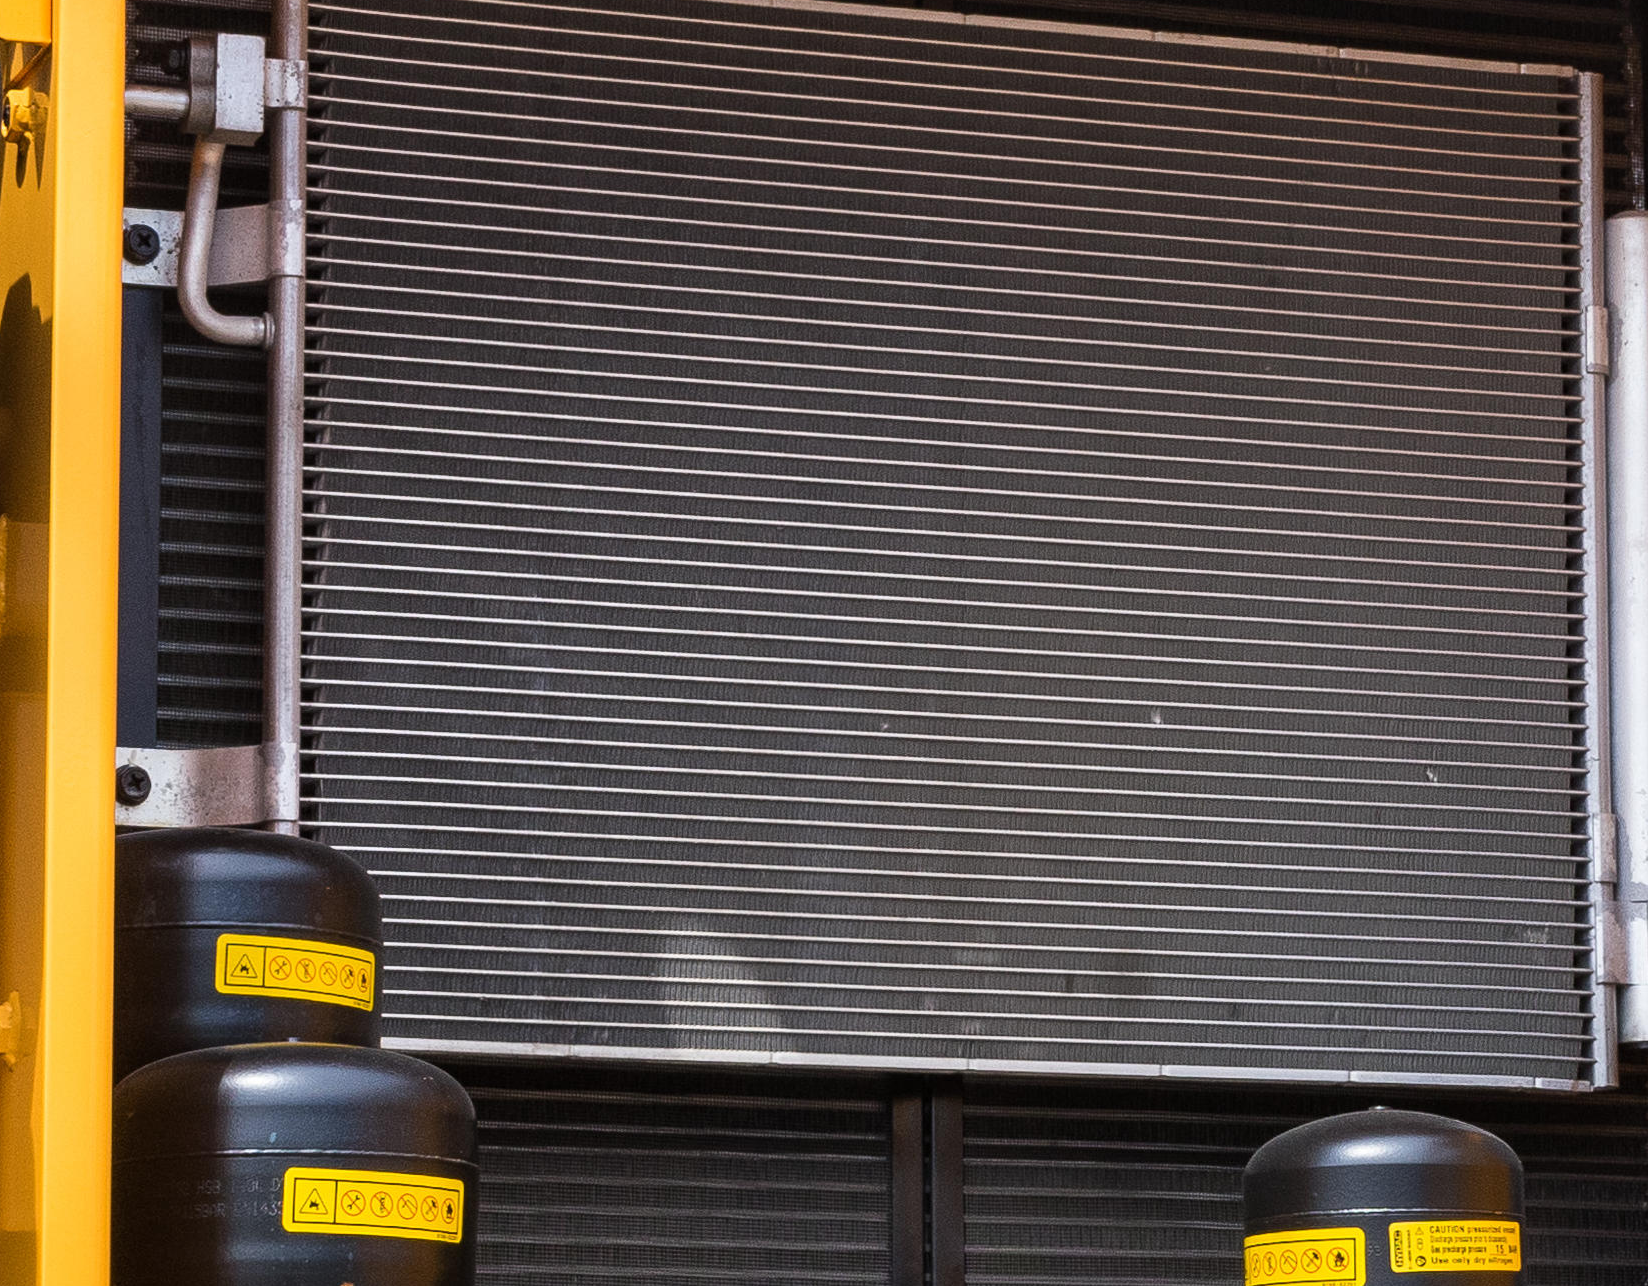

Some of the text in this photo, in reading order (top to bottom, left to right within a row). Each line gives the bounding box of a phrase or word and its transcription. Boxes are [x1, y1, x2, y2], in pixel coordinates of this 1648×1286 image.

[1429, 1226, 1465, 1234] CAUTION
[1451, 1256, 1470, 1266] only
[1473, 1256, 1486, 1265] dry
